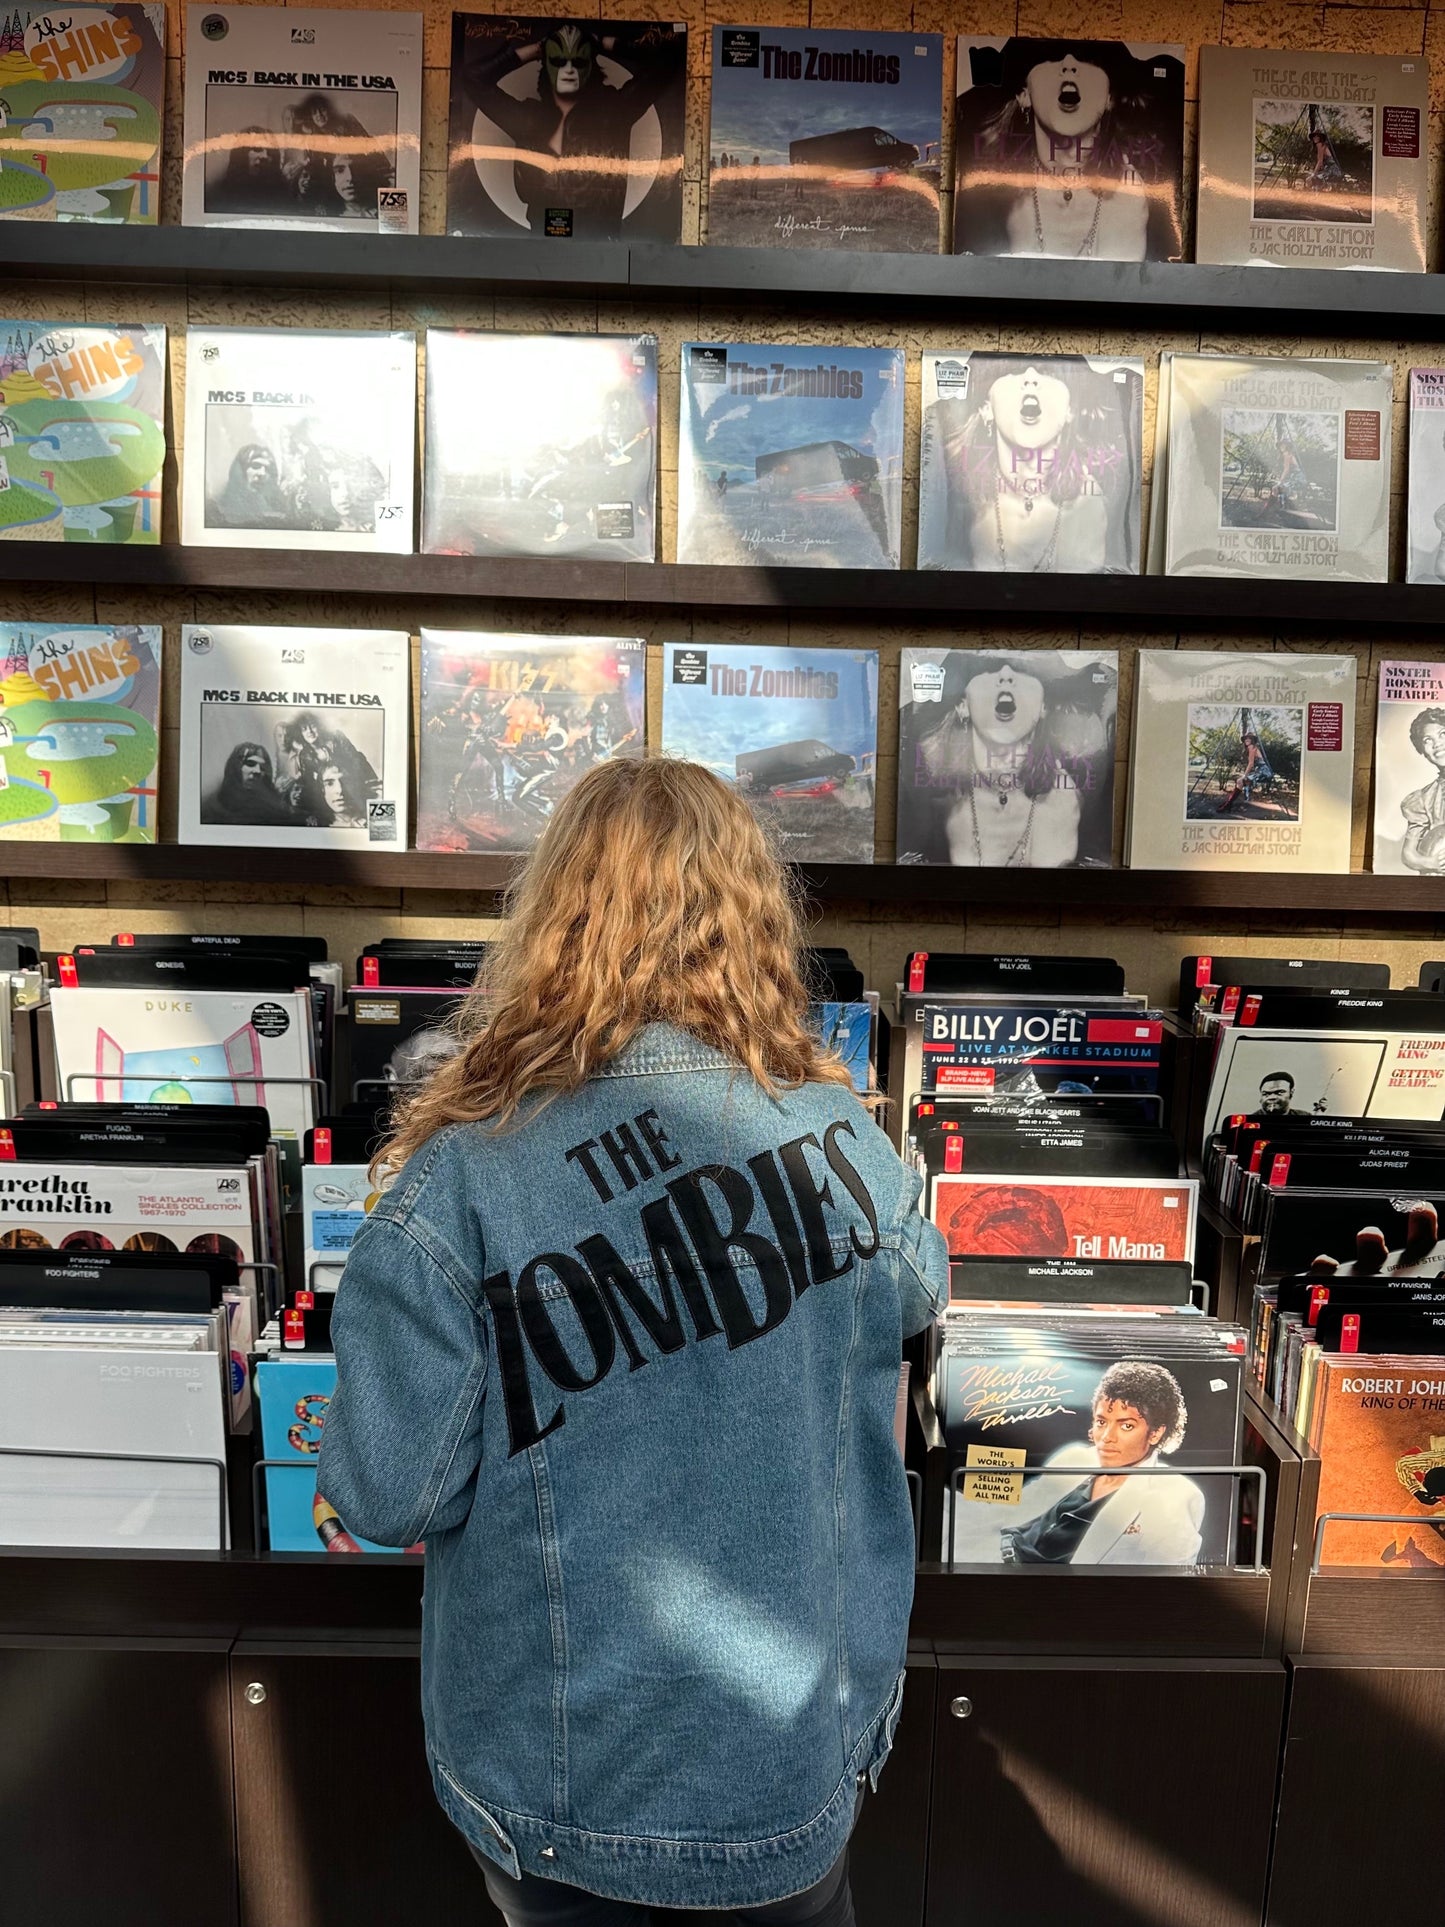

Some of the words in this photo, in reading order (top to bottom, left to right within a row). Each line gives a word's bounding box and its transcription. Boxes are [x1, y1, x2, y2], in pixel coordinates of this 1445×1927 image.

[33, 16, 73, 43] the
[30, 15, 144, 82] SHINS
[761, 46, 802, 80] The
[804, 47, 901, 85] Zombies
[208, 70, 247, 83] MC5
[254, 71, 298, 85] BACK
[302, 73, 321, 86] IN
[323, 74, 358, 87] THE
[362, 76, 396, 89] USA
[1252, 68, 1298, 84] THESE
[1301, 71, 1328, 86] ARE
[1331, 72, 1359, 87] THE
[1270, 84, 1310, 98] GOOD
[1313, 85, 1341, 100] OLD
[1344, 87, 1377, 101] DAYS
[974, 134, 1033, 161] LIZ
[1050, 134, 1165, 167] PHAIR
[774, 215, 832, 238] different
[1249, 226, 1273, 240] THE
[1278, 226, 1323, 243] CARLY
[1326, 228, 1375, 245] SIMON
[1249, 242, 1257, 254] &
[1260, 243, 1281, 255] JAC
[1283, 243, 1337, 258] HOLZMAN
[1338, 246, 1376, 259] STORY
[35, 338, 76, 363] the
[34, 335, 145, 399] SHINS
[728, 362, 768, 397] The
[770, 363, 864, 399] Zombies
[1269, 380, 1296, 395] ARE
[1299, 382, 1326, 396] THE
[208, 391, 246, 403] MC5
[252, 391, 294, 404] BACK
[1010, 446, 1125, 477] PHAIR
[740, 529, 796, 550] different
[1217, 535, 1240, 547] THE
[1244, 534, 1289, 550] CARLY
[1292, 536, 1338, 552] SIMON
[1250, 551, 1302, 564] HOLZMAN
[1303, 553, 1338, 566] STORY
[37, 638, 76, 664] the
[34, 638, 142, 702] SHINS
[488, 660, 559, 693] KISS
[1386, 667, 1432, 678] SISTER
[709, 664, 747, 696] The
[750, 665, 839, 699] Zombies
[1236, 676, 1260, 689] ARE
[1265, 677, 1290, 689] THE
[1385, 678, 1445, 690] ROSETTA
[203, 690, 240, 701] MC5
[247, 690, 288, 703] BACK
[292, 692, 310, 703] IN
[313, 693, 346, 705] THE
[350, 694, 382, 706] USA
[1205, 688, 1243, 701] GOOD
[1250, 689, 1275, 701] OLD
[1277, 690, 1307, 703] DAYS
[1385, 689, 1439, 700] THARPE
[986, 744, 1096, 770] PHAIR
[973, 772, 992, 788] IN
[1182, 826, 1204, 840] THE
[1209, 826, 1252, 840] CARLY
[1255, 827, 1302, 842] SIMON
[1181, 842, 1189, 853] &
[1192, 842, 1212, 853] JAC
[1214, 842, 1265, 855] HOLZMAN
[1266, 843, 1302, 855] STORY
[192, 936, 222, 944] GRATEFUL
[145, 1001, 193, 1013] DUKE
[933, 1014, 1003, 1041] BILLY
[1009, 1016, 1081, 1042] JOEL
[960, 1044, 992, 1054] LIVE
[998, 1045, 1016, 1054] AT
[1021, 1045, 1079, 1056] YANKEE
[1085, 1047, 1151, 1057] STADIUM
[1397, 1050, 1429, 1059] KING
[932, 1056, 955, 1064] JUNE
[998, 1057, 1019, 1065] 1990
[1391, 1069, 1444, 1079] GETTING
[1388, 1078, 1437, 1088] READY...
[565, 1109, 683, 1203] THE
[1073, 1235, 1100, 1258] Tell
[1108, 1236, 1166, 1259] Mama
[63, 1270, 100, 1279] FIGHTERS
[1060, 1268, 1093, 1276] JACKSON
[483, 1120, 880, 1459] ZOMBIES
[100, 1365, 131, 1377] FOO
[134, 1366, 201, 1378] FIGHTERS
[959, 1361, 1070, 1393] Michael
[1341, 1378, 1404, 1394] ROBERT
[962, 1386, 1073, 1422] Jackson
[1361, 1397, 1394, 1409] KING
[1398, 1398, 1416, 1410] OF
[1421, 1398, 1445, 1411] THE
[979, 1405, 1076, 1431] Thriller
[977, 1458, 1015, 1467] WORLD'S
[972, 1483, 1001, 1491] ALBUM
[978, 1475, 1010, 1484] SELLING
[991, 1493, 1010, 1501] TIME
